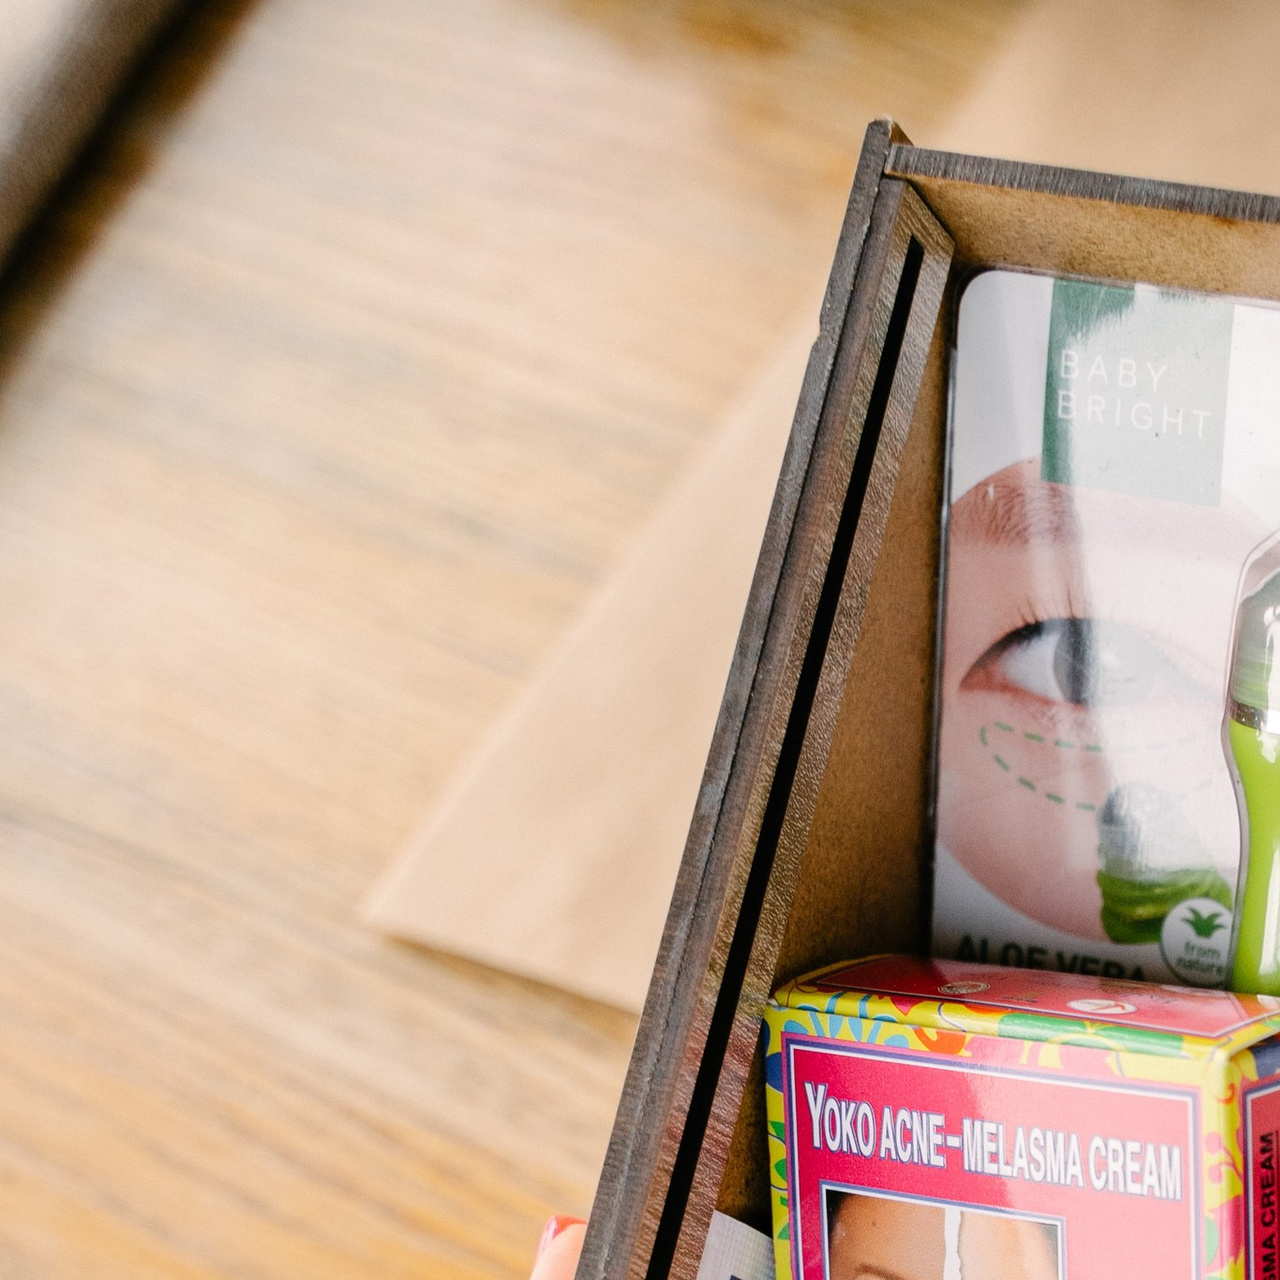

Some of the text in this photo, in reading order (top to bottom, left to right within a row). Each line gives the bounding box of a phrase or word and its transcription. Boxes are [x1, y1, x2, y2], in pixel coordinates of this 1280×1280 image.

[1060, 350, 1167, 391] BABY
[1057, 390, 1212, 439] BRIGHT
[804, 1081, 876, 1157] YOKO
[1088, 1137, 1184, 1201] CREAM
[1259, 1131, 1275, 1227] CREAM
